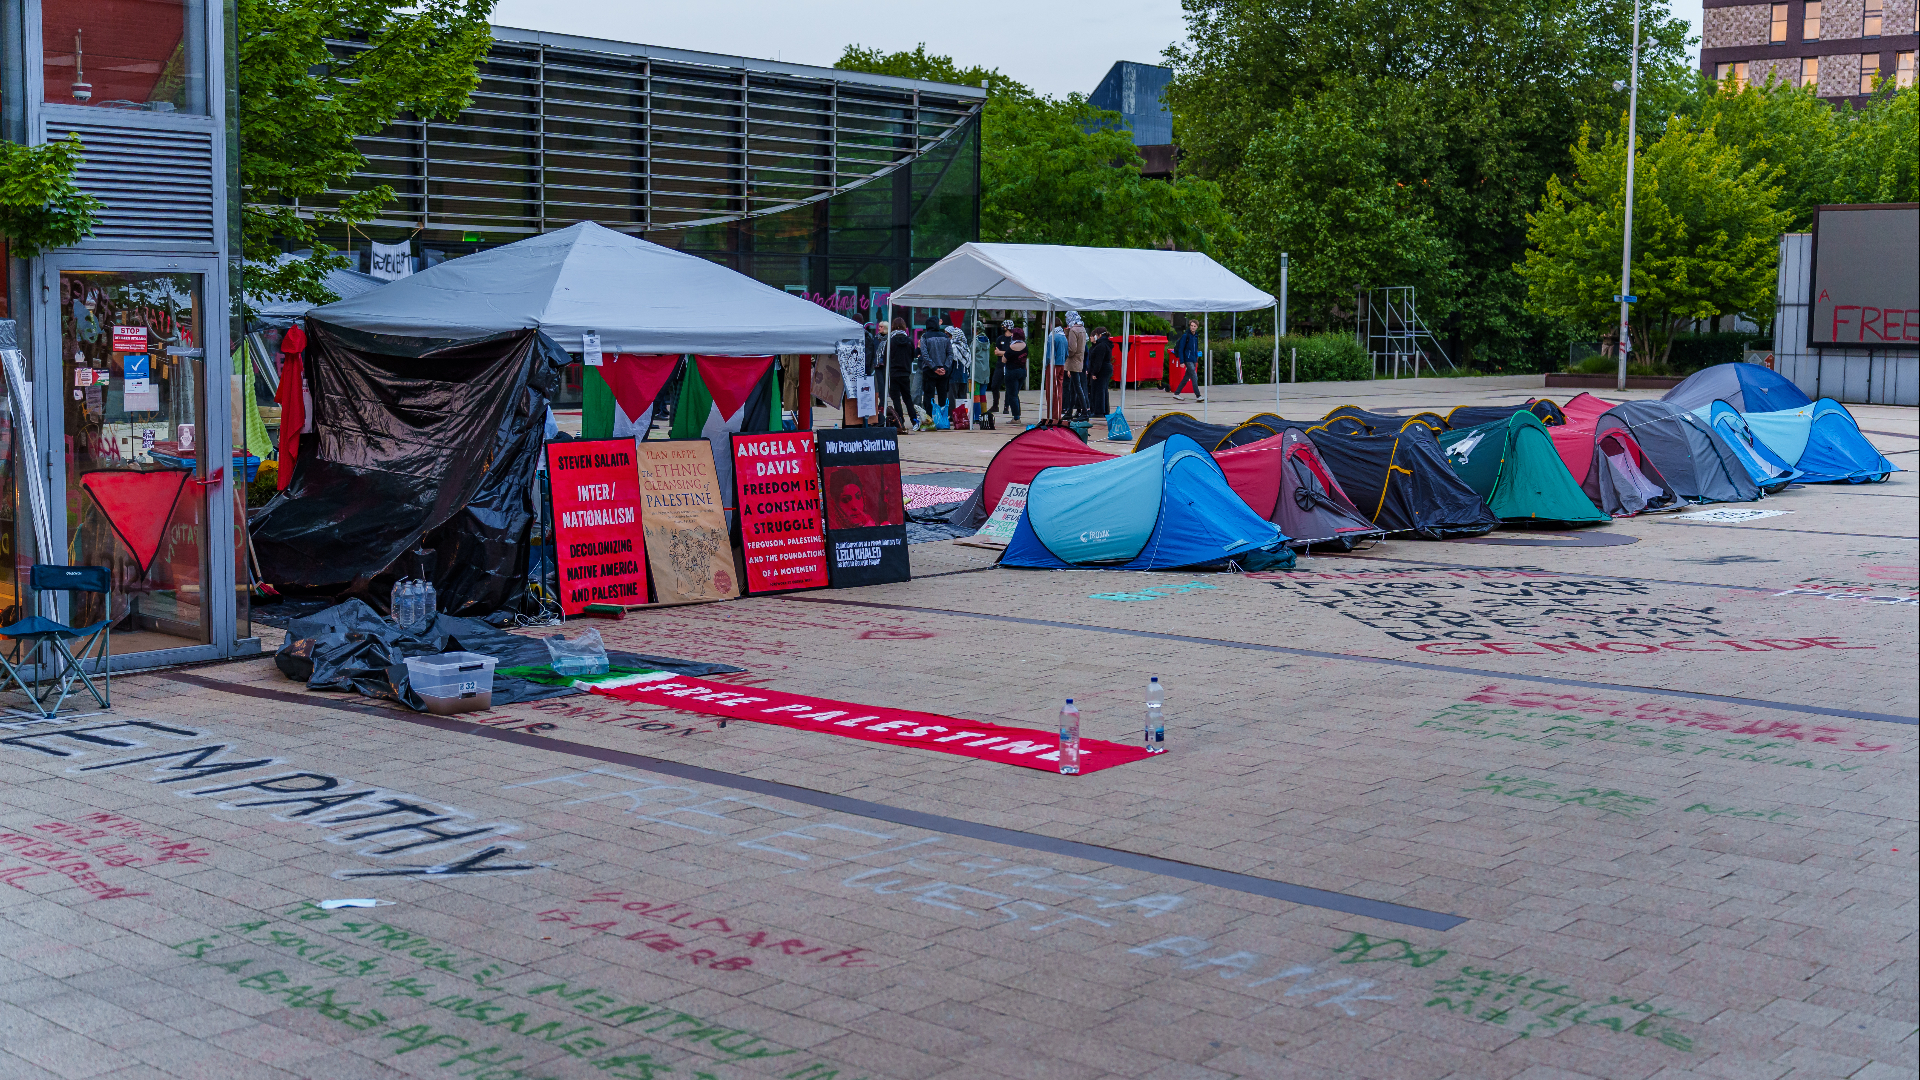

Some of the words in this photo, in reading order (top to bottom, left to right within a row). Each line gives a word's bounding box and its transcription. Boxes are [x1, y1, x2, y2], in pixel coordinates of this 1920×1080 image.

[859, 294, 870, 310] to
[1818, 288, 1831, 303] A
[120, 327, 140, 335] STOP
[737, 440, 797, 457] ANGELA
[802, 440, 814, 453] Y.
[826, 440, 838, 454] My
[838, 441, 863, 454] People
[863, 440, 881, 452] Shall
[881, 439, 896, 451] Live
[558, 454, 592, 471] STEVEN
[594, 452, 630, 468] SALAITA
[756, 459, 800, 477] DAVIS
[642, 470, 653, 478] The
[654, 463, 707, 478] ETHNIC
[644, 479, 702, 491] CLEANSING
[703, 481, 711, 492] of
[743, 481, 800, 496] FREEDOM
[805, 479, 816, 491] IS
[645, 492, 713, 508] PALESTINE
[744, 504, 753, 516] A
[757, 498, 819, 514] CONSTANT
[562, 507, 635, 529] NATIONALISM
[754, 518, 815, 535] STRUGGLE
[569, 539, 632, 558] DECOLONIZING
[747, 539, 786, 550] FERGUSON,
[748, 555, 764, 564] AND
[765, 554, 778, 562] THE
[780, 549, 826, 561] FOUNDATIONS
[566, 565, 598, 582] NATIVE
[600, 560, 639, 578] AMERICA
[762, 569, 772, 577] OF
[773, 568, 779, 577] A
[780, 564, 817, 576] MOVEMENT
[1243, 571, 1560, 580] GENOCIDE
[571, 588, 590, 603] AND
[591, 582, 638, 600] PALESTINE
[1262, 581, 1338, 590] IF
[1292, 589, 1456, 598] LIKE
[1471, 588, 1650, 597] WHAT
[1298, 599, 1444, 609] YOU
[1339, 609, 1515, 620] LOOK
[1358, 618, 1541, 628] LIKE
[1554, 616, 1723, 628] YOU
[1384, 630, 1493, 642] DO
[1505, 627, 1731, 640] WITH
[1415, 636, 1878, 655] GENOCIDE
[636, 682, 769, 707] FREE
[760, 703, 1092, 764] PALESTINE
[1449, 703, 1698, 739] COURAGE
[1724, 738, 1797, 751] OF
[1432, 711, 1524, 728] THE
[1542, 725, 1863, 772] PALESTINIAN
[0, 719, 545, 878] EMPATHY
[1484, 772, 1559, 789] WE
[1684, 802, 1802, 822] NOT
[76, 811, 122, 824] IN
[32, 821, 110, 846] EVIL
[91, 844, 143, 867] HAS
[502, 768, 894, 861] FREE
[906, 851, 1187, 918] GAZA
[579, 890, 878, 969] SOLIDARITY
[535, 908, 581, 923] IS
[569, 920, 619, 936] A
[624, 928, 755, 972] VERB
[842, 866, 1112, 932] WEST
[1126, 934, 1395, 1018] BANK
[199, 958, 254, 975] A
[224, 919, 273, 935] A
[429, 994, 608, 1058] INSANE
[284, 901, 331, 921] TO
[328, 921, 505, 993] STRUGGLE
[527, 983, 798, 1066] MENTALLY
